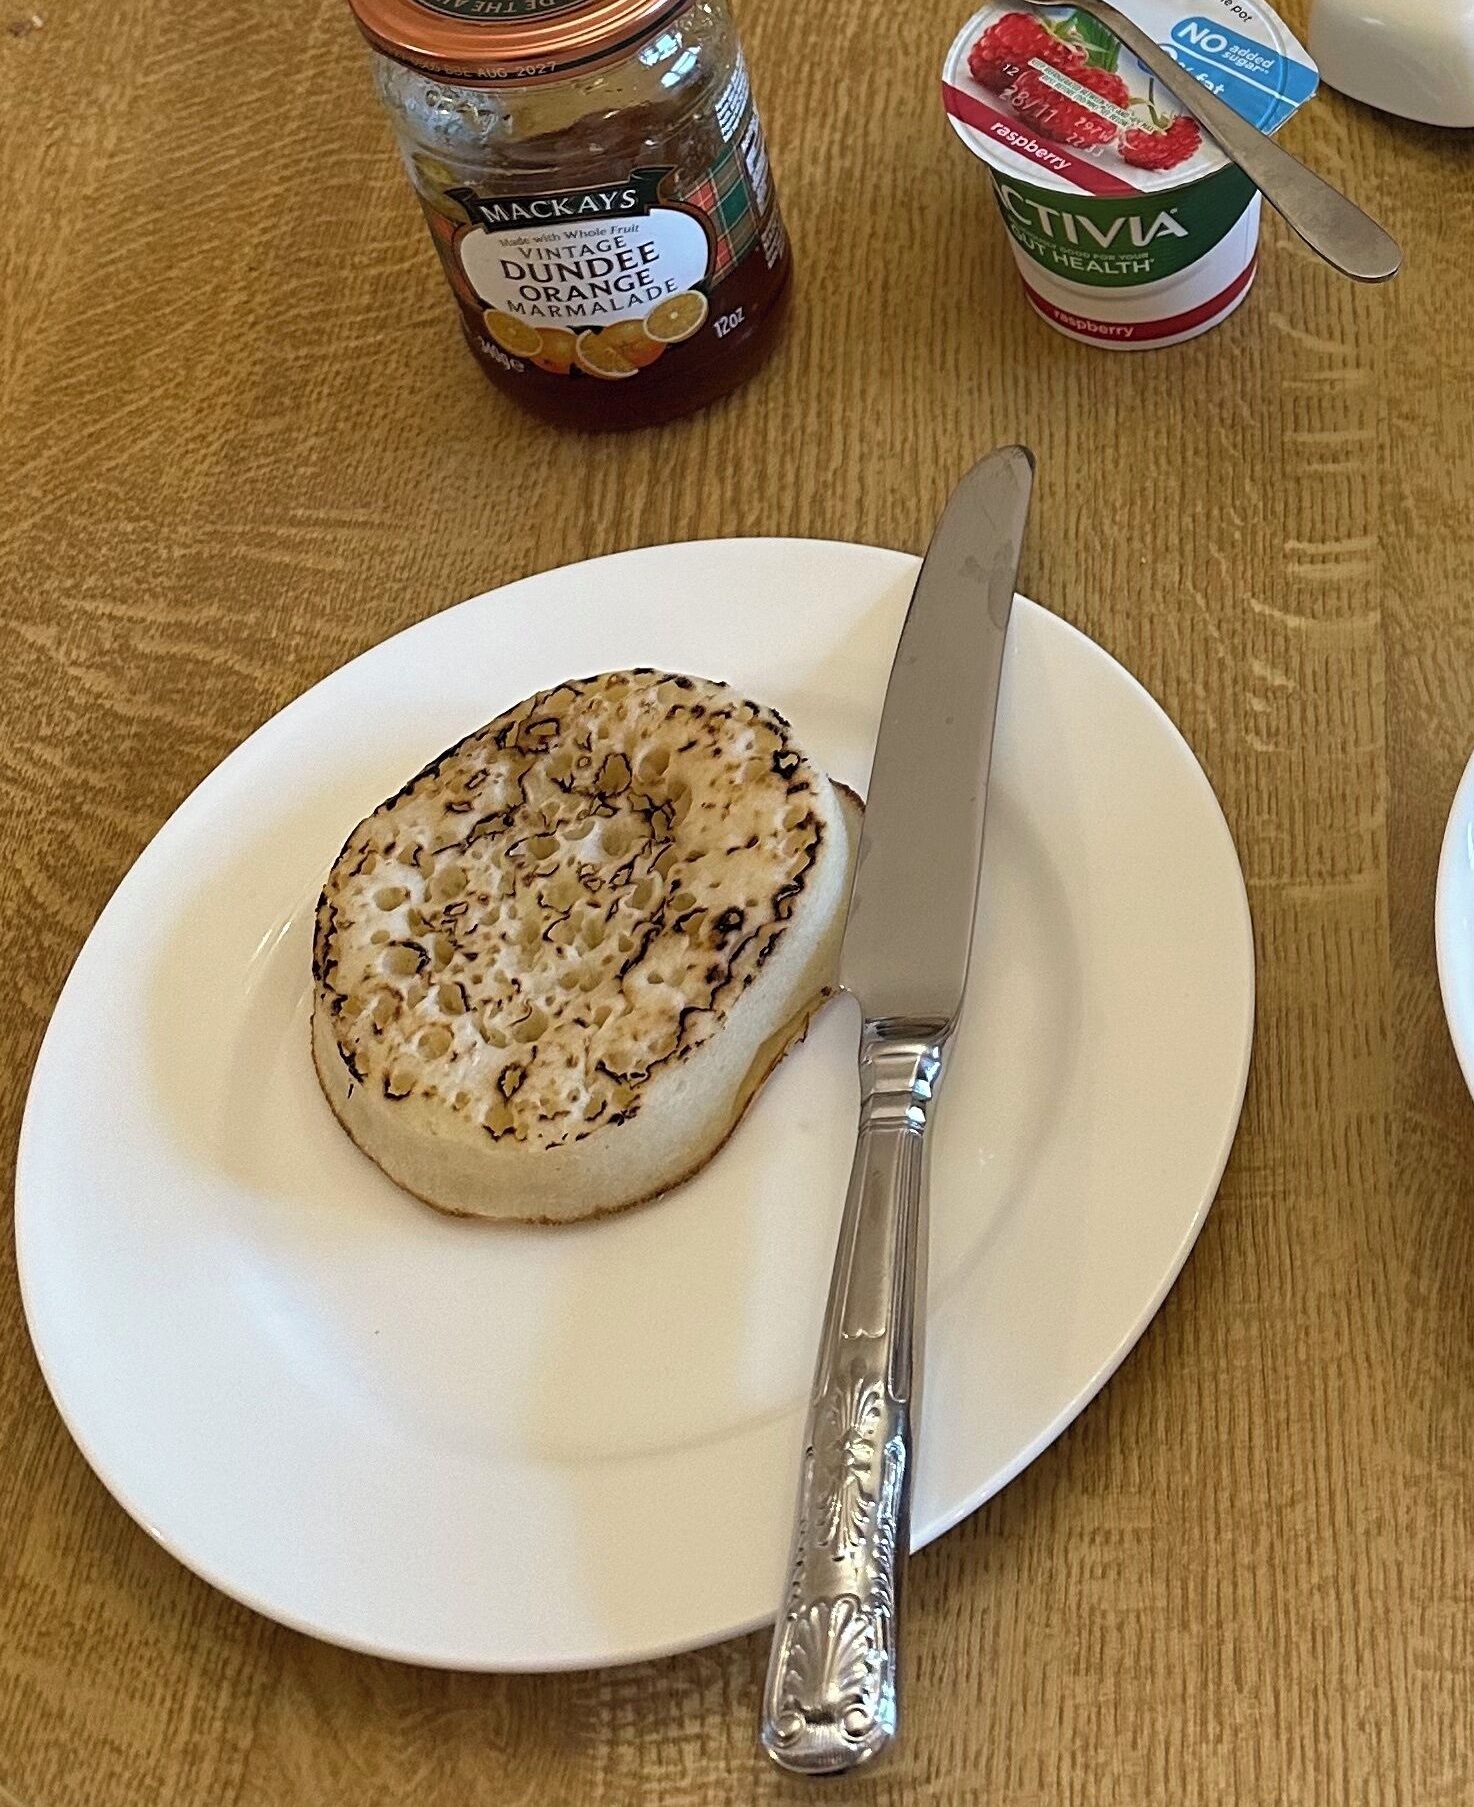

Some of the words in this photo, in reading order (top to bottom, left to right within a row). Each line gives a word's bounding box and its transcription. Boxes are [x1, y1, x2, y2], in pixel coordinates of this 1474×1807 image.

[471, 0, 517, 14] THE
[1231, 4, 1253, 22] pot
[1177, 22, 1227, 53] NO
[478, 65, 508, 79] AUG
[517, 60, 557, 78] 2027
[1229, 44, 1275, 68] added
[999, 85, 1058, 123] 28/11
[990, 122, 1071, 171] raspberry
[480, 189, 637, 223] MACKAYS
[1000, 184, 1189, 249] CTIVIA
[500, 236, 530, 248] Made
[533, 232, 560, 246] with
[563, 225, 607, 241] Whole
[611, 224, 640, 236] Fruit
[518, 235, 627, 261] VINTAGE
[500, 241, 660, 283] DUNDEE
[1094, 252, 1116, 261] FOR
[1119, 252, 1149, 261] YOUR
[507, 278, 679, 318] MARMALADE
[520, 268, 654, 303] ORANGE
[713, 306, 745, 338] 12oz
[1053, 310, 1134, 337] raspberry
